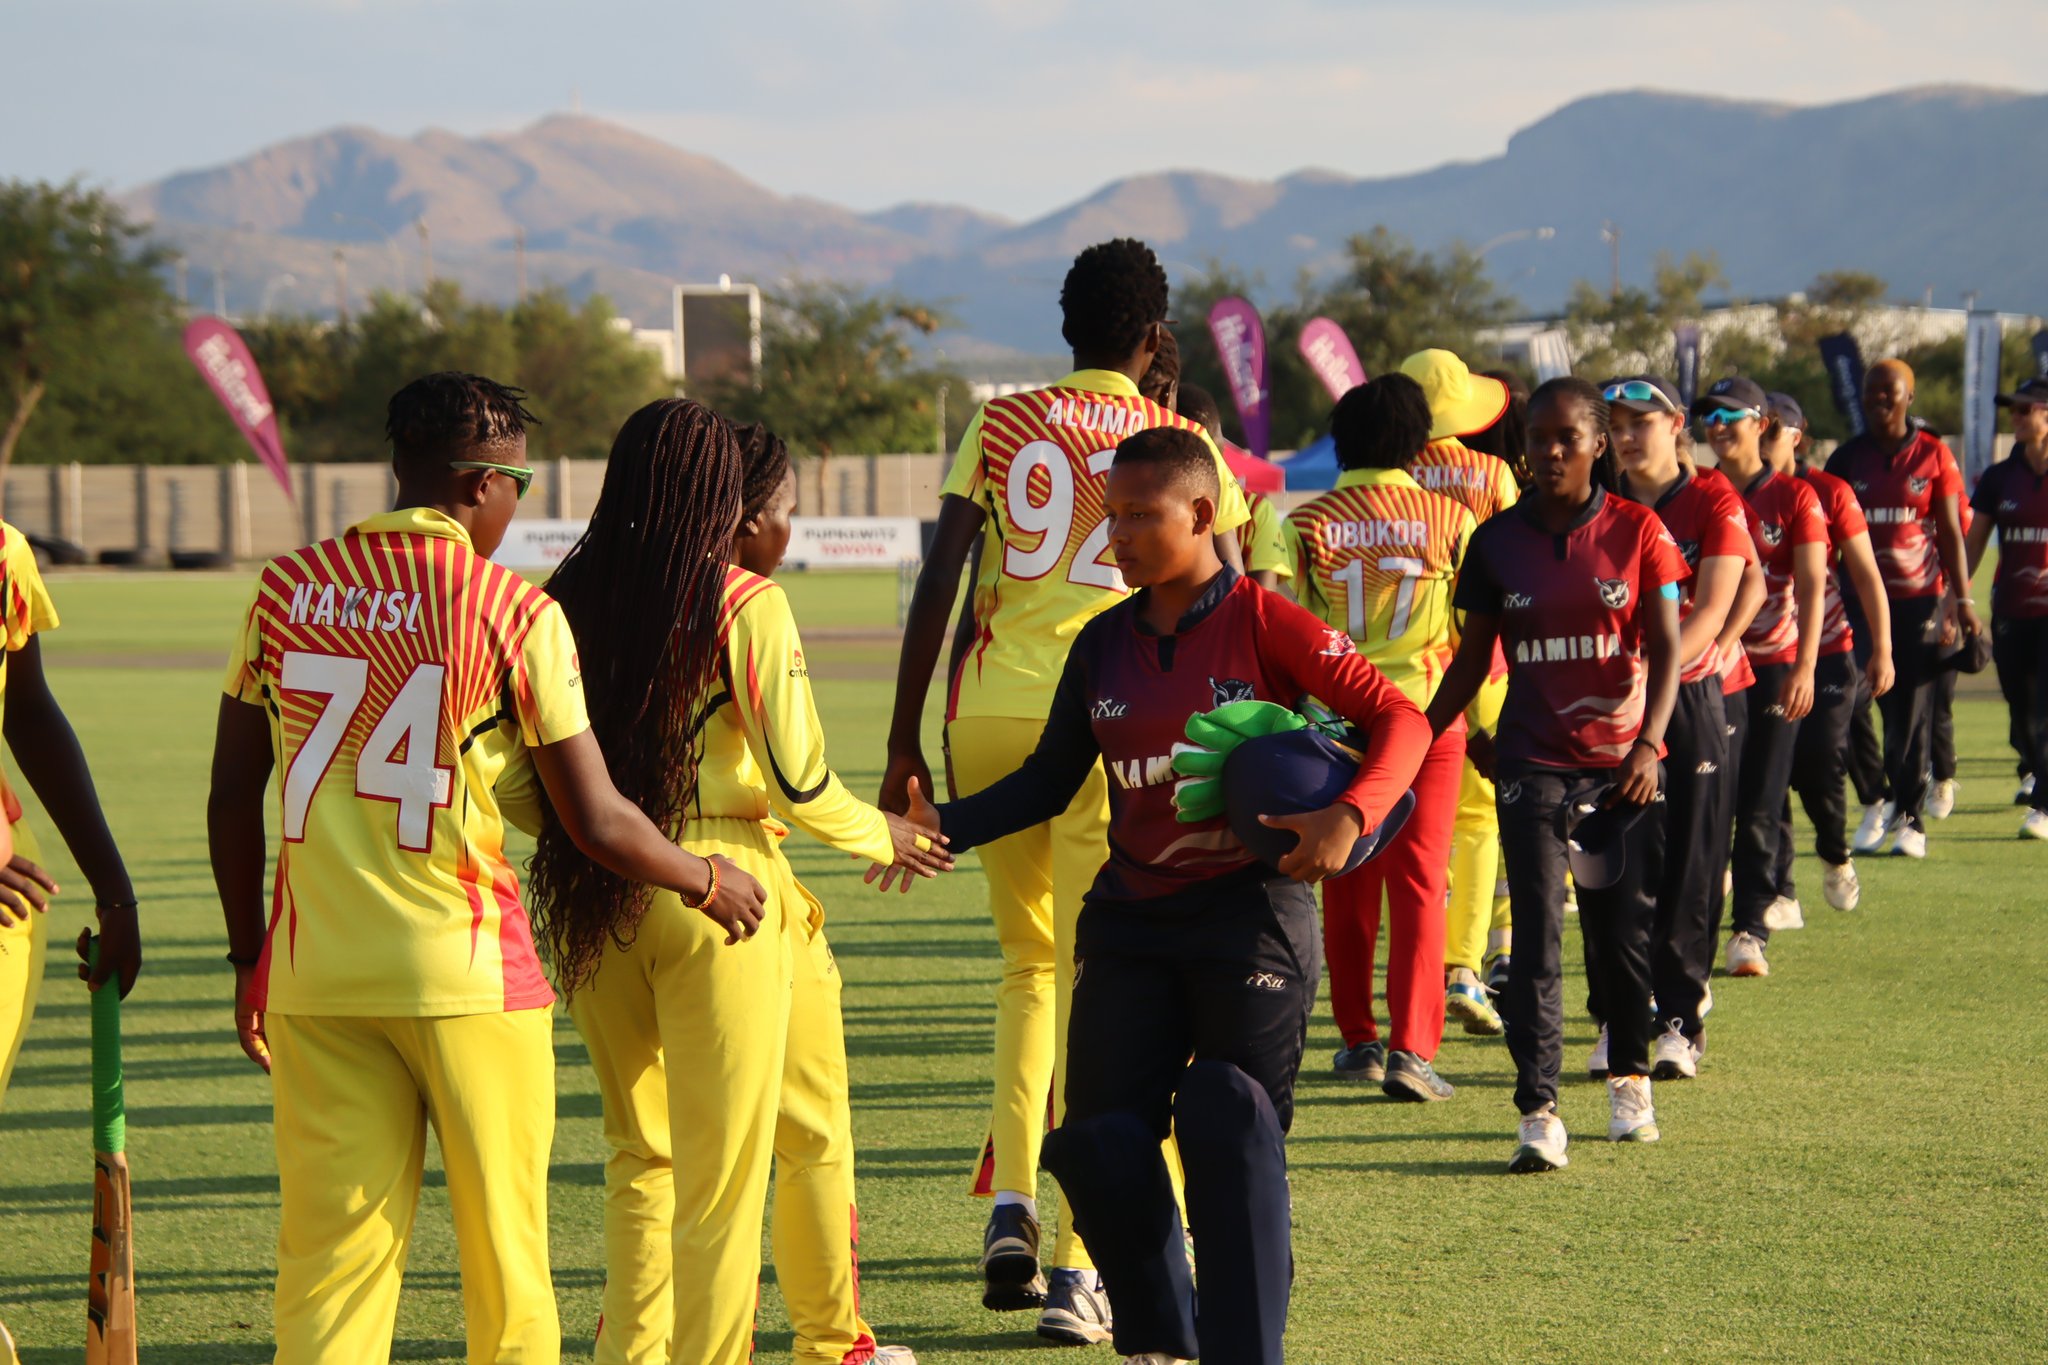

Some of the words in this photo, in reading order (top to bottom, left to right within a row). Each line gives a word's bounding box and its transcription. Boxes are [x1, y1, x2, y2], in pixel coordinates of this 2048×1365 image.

[1045, 398, 1146, 436] ALUMO
[1326, 518, 1428, 549] OBUKOR
[1331, 556, 1425, 641] 17
[1516, 633, 1621, 663] NAMIBIA
[280, 650, 456, 854] 74
